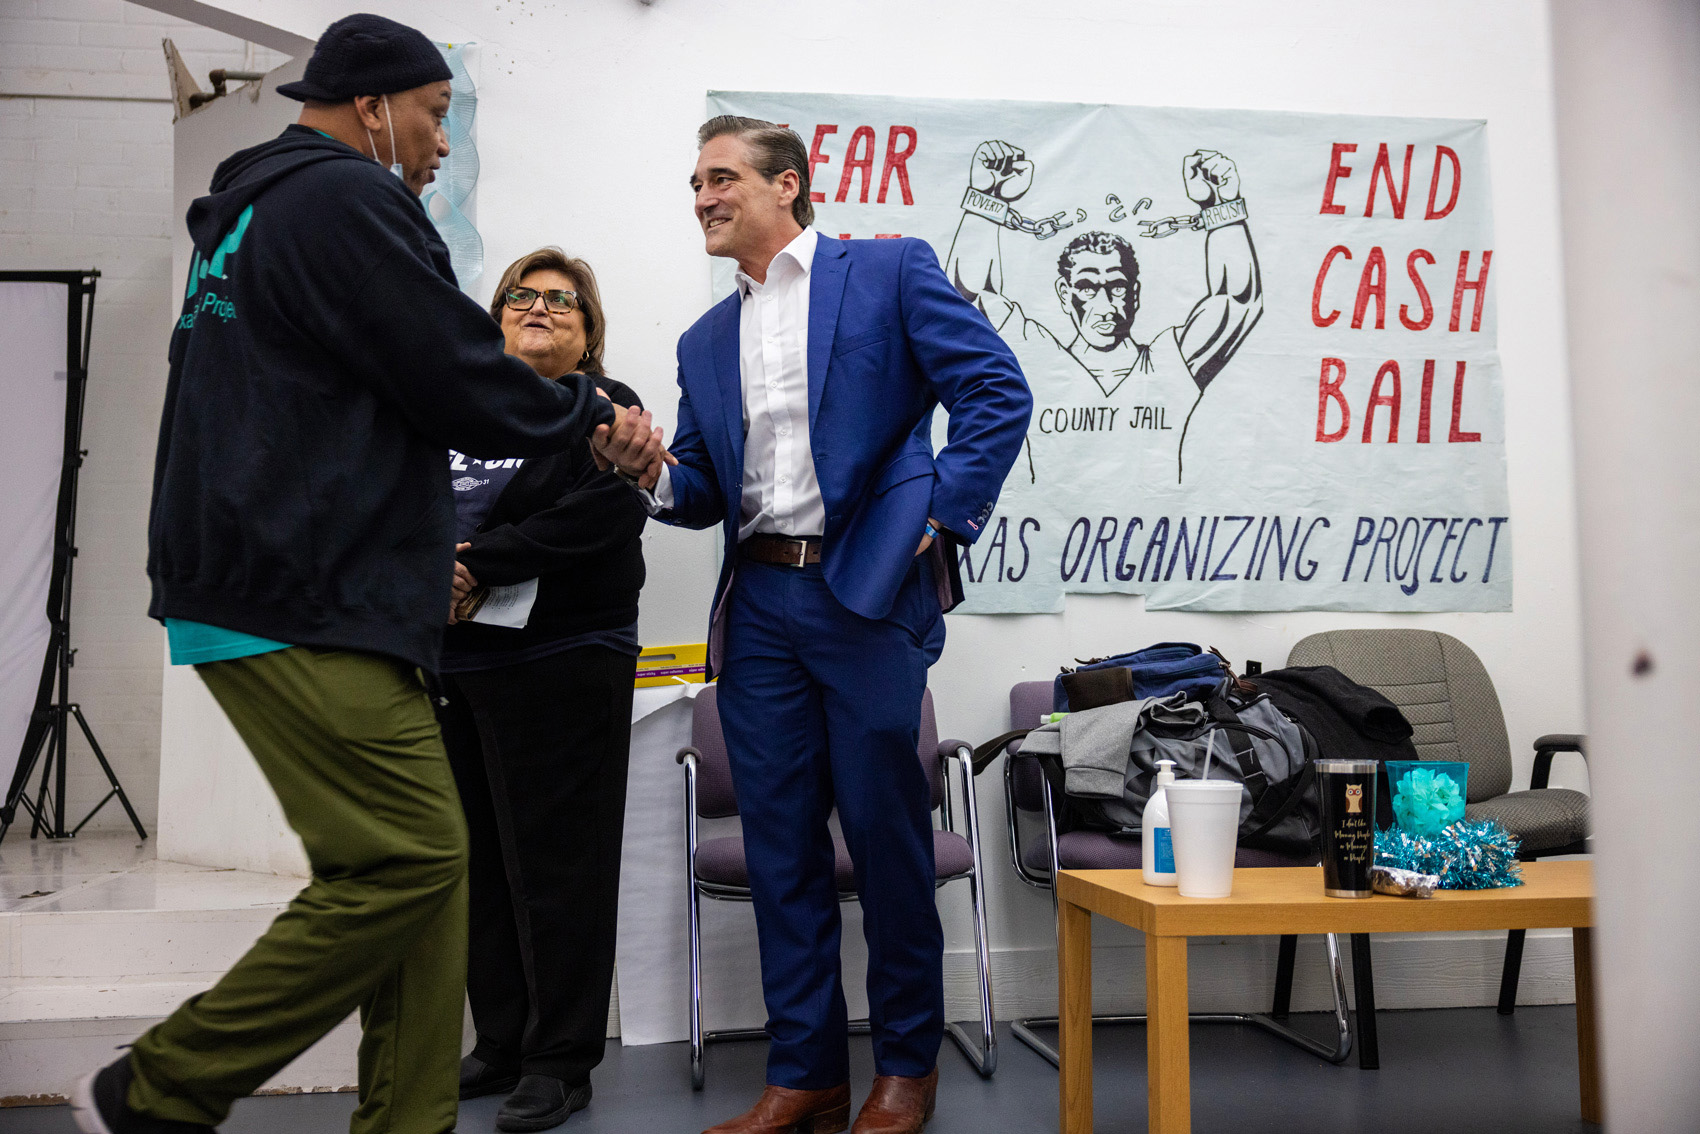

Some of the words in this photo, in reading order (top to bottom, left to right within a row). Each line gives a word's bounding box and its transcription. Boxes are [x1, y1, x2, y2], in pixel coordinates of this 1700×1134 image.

[777, 124, 917, 205] EAR
[966, 190, 1005, 213] POVERTY
[1319, 142, 1461, 220] END
[1205, 199, 1245, 228] RACISM
[1312, 245, 1493, 332] CASH
[1039, 407, 1119, 434] COUNTY
[1130, 406, 1172, 430] JAIL
[1315, 357, 1481, 443] BAIL
[1061, 516, 1330, 582] ORGANIZING
[1342, 516, 1508, 596] PROJECT
